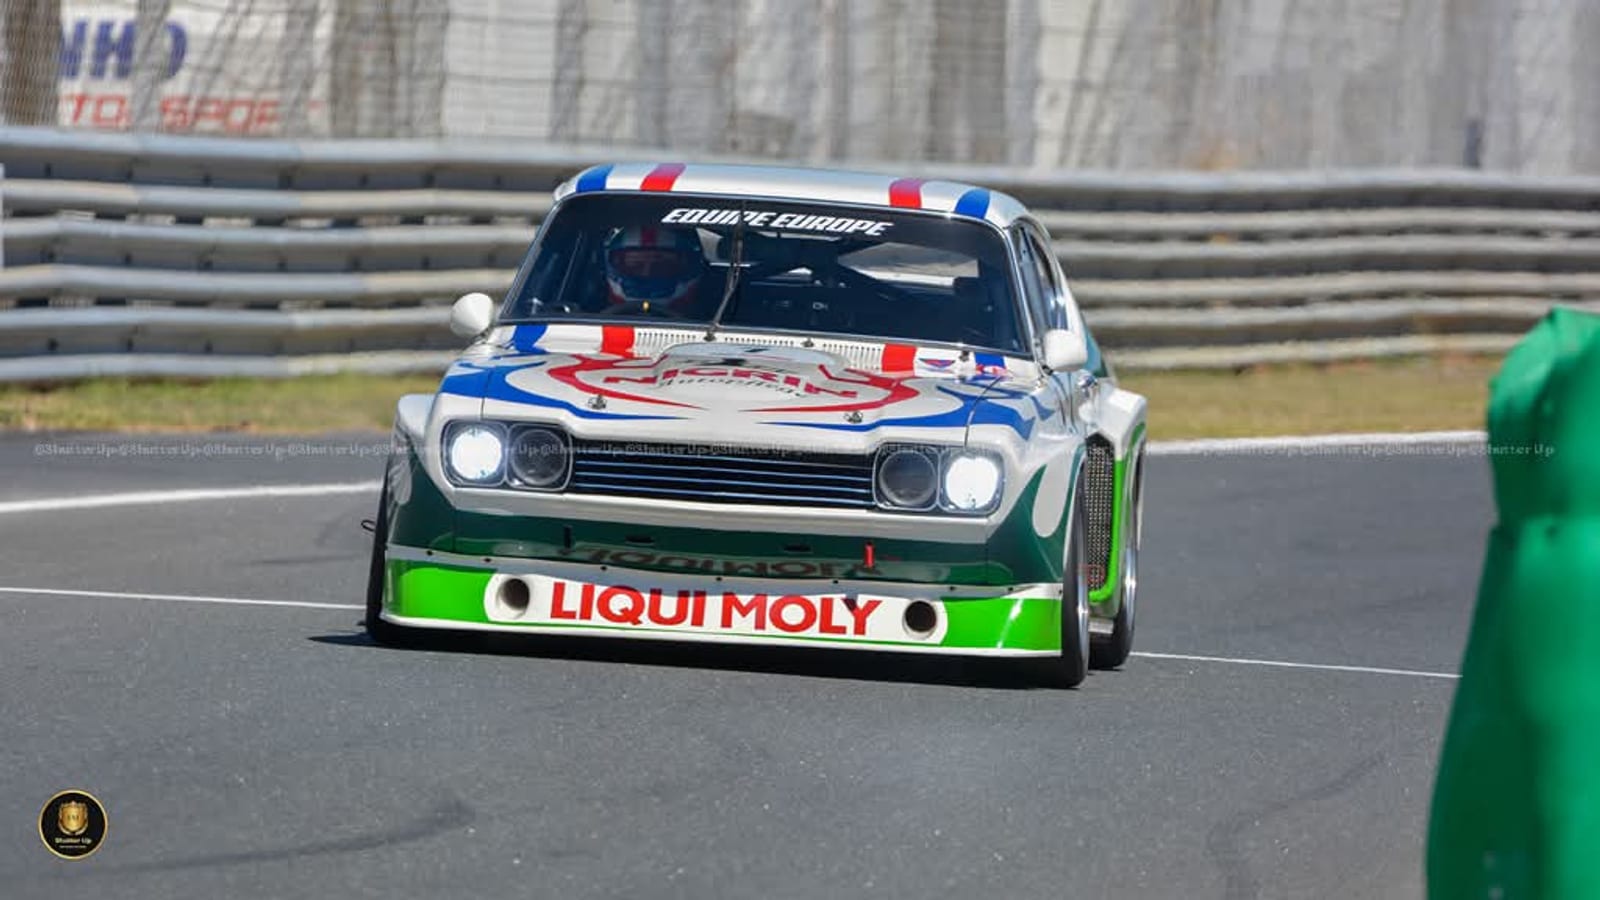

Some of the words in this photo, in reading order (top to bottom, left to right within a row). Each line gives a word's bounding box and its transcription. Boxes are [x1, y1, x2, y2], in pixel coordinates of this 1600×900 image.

[661, 208, 777, 227] EQUIPE
[769, 213, 894, 237] EUROPE
[549, 581, 706, 627] LIQUI
[720, 591, 883, 636] MOLY
